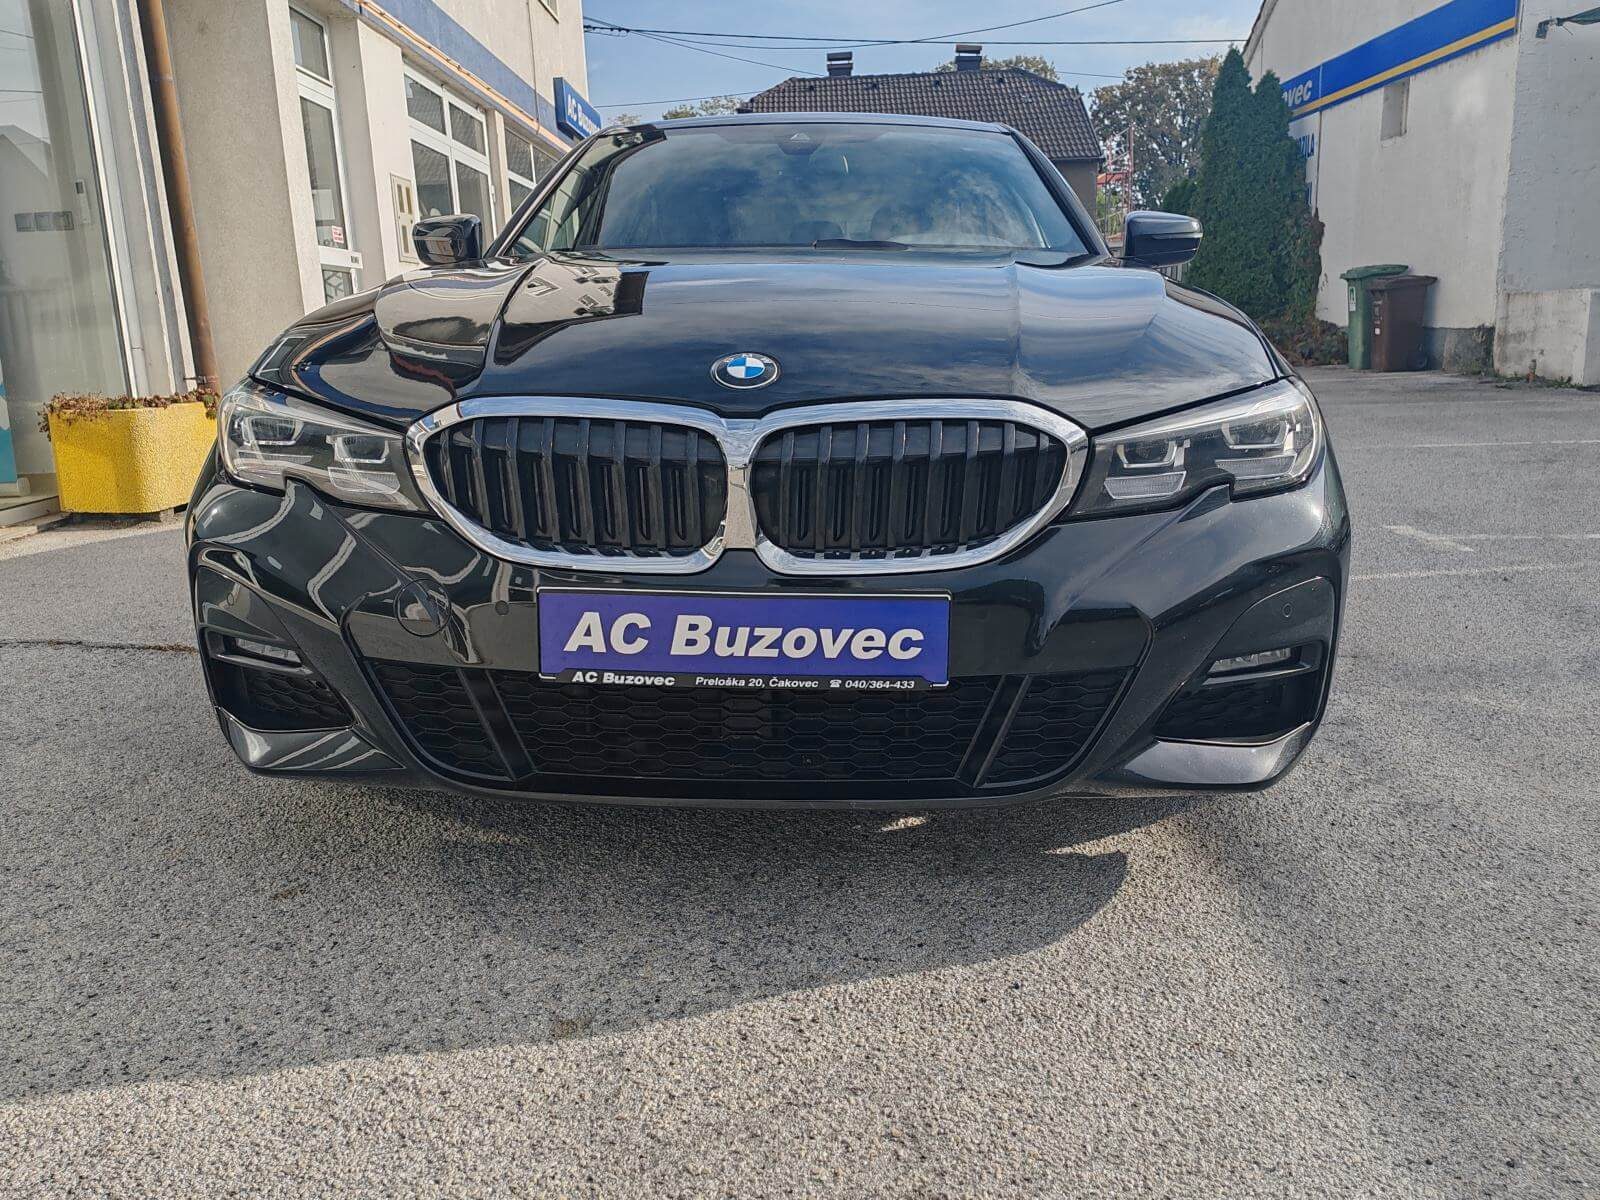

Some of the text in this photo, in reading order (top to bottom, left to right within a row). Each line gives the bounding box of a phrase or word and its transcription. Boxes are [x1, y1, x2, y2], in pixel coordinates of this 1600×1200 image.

[567, 93, 577, 122] AC
[563, 611, 924, 660] AC Buzovec
[571, 671, 915, 689] AC Buzovec Preloška 20, Čakovec 040/364-433
